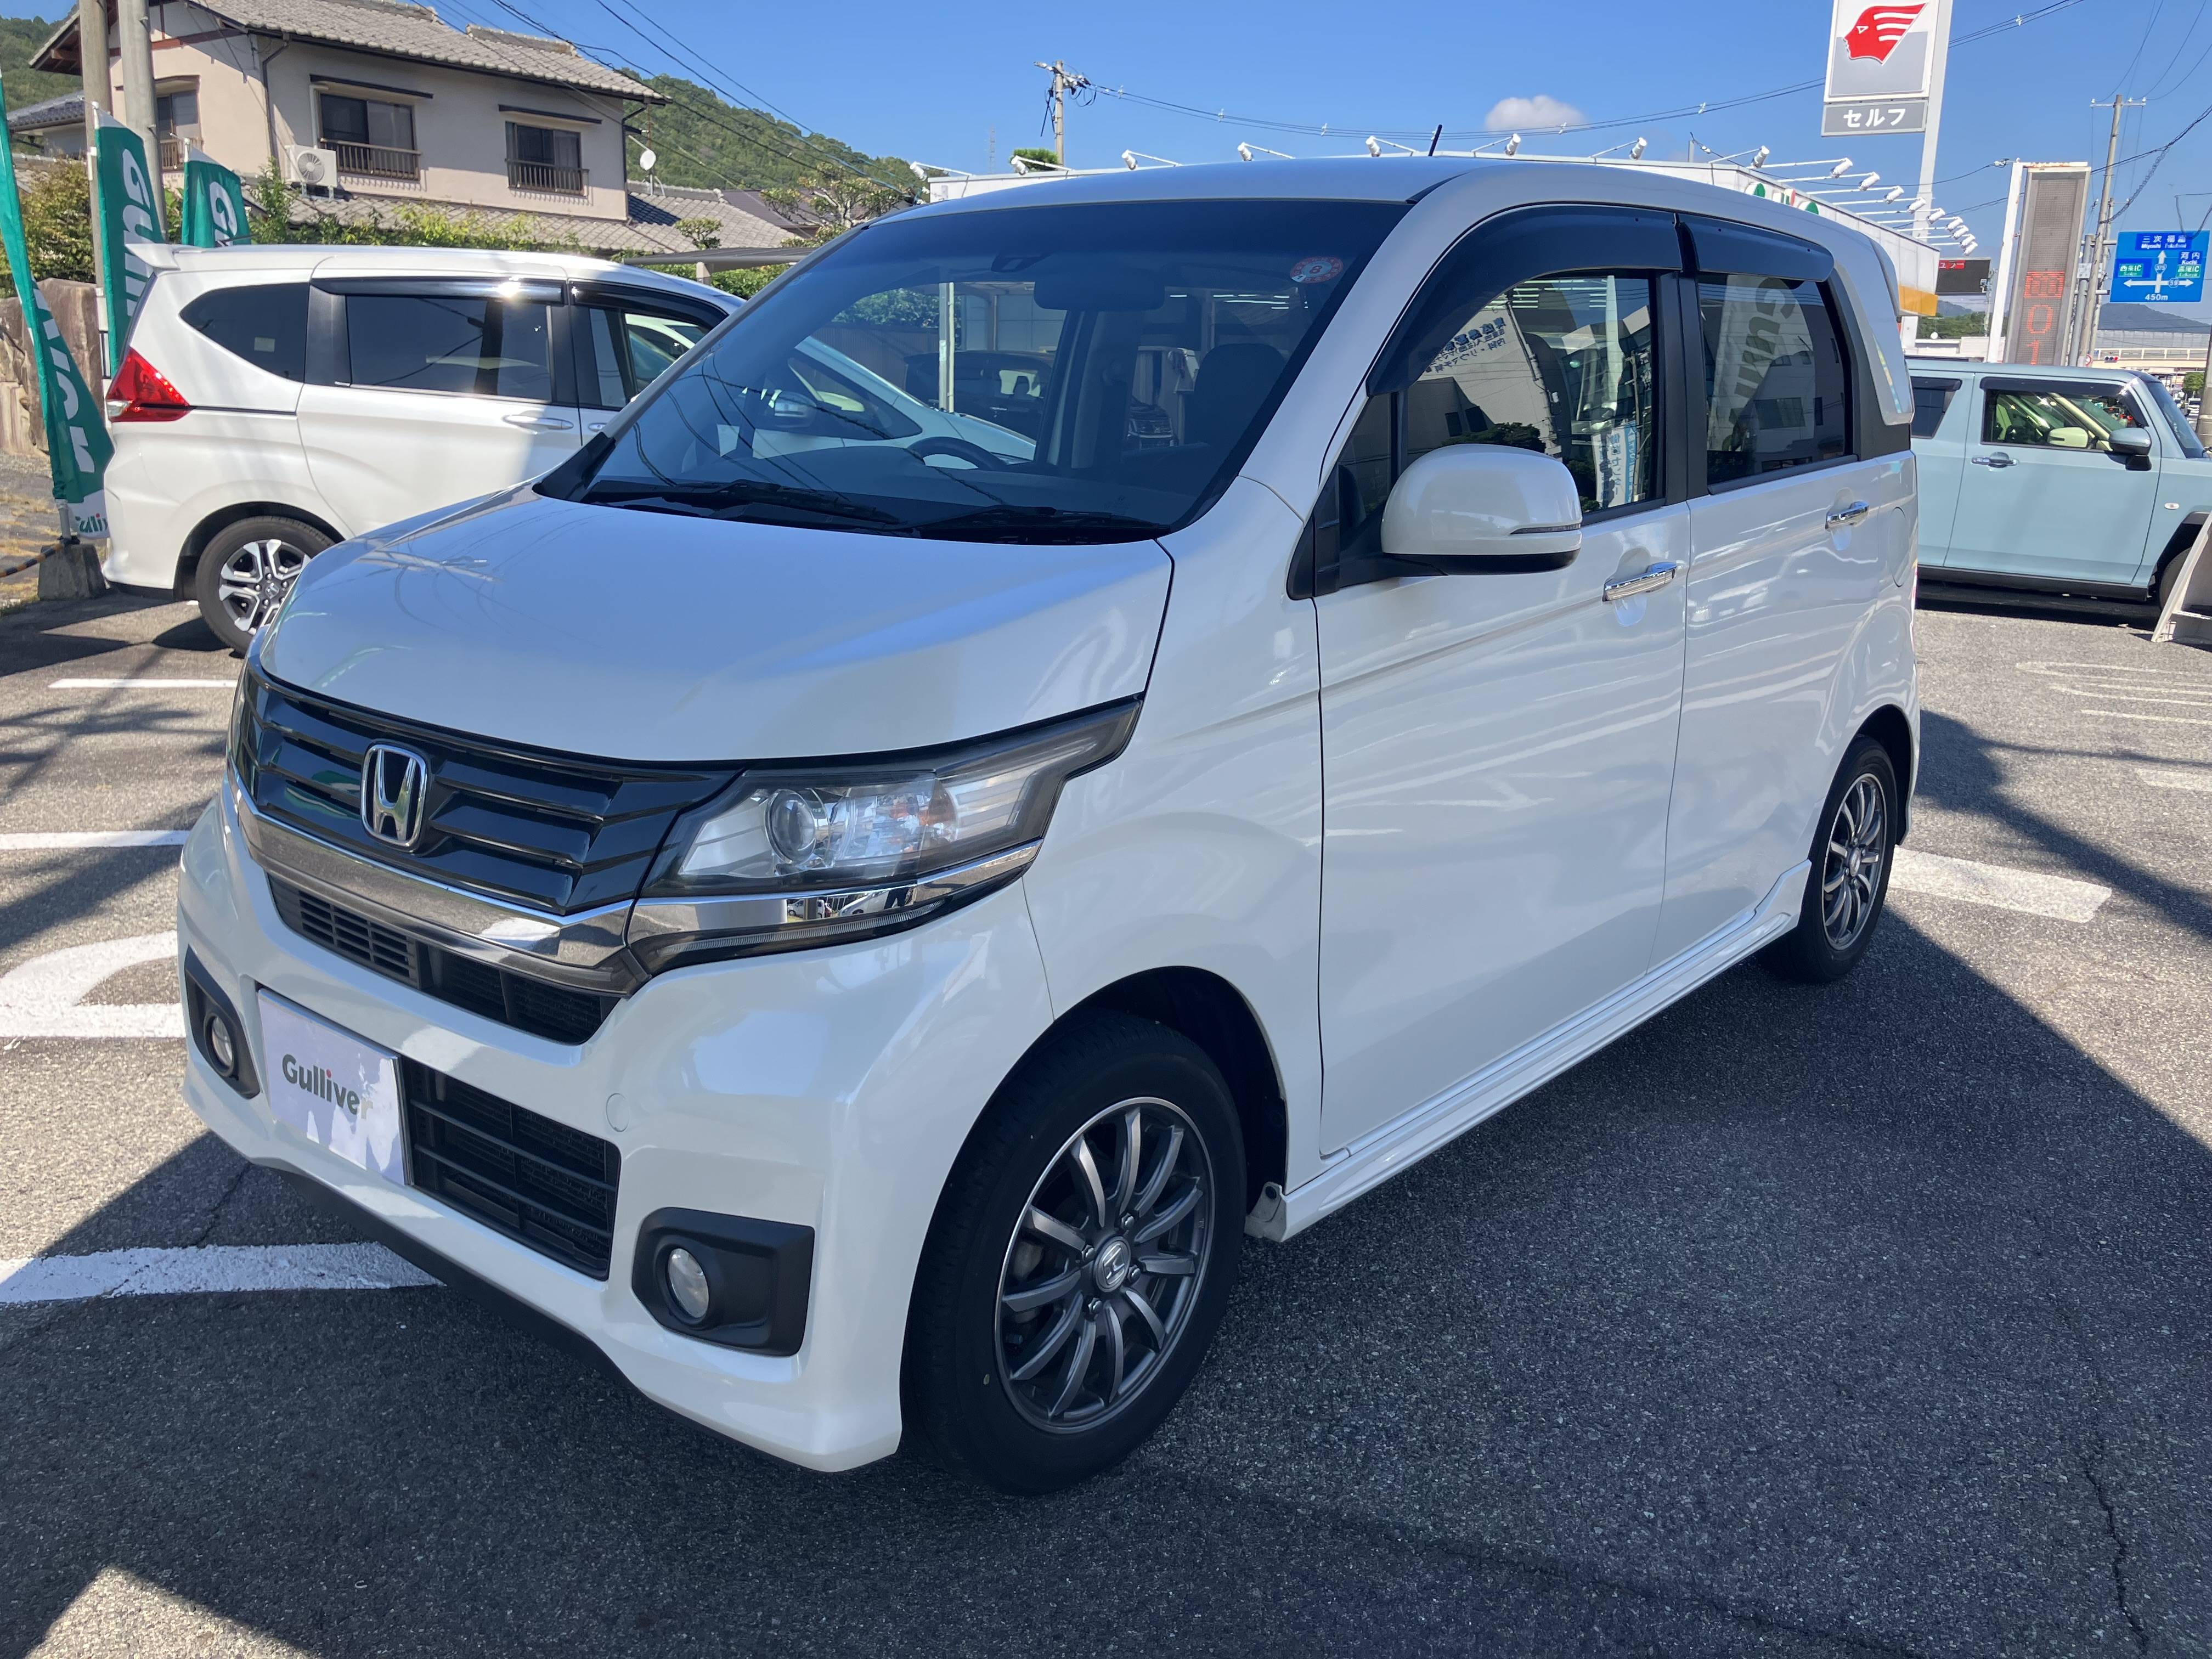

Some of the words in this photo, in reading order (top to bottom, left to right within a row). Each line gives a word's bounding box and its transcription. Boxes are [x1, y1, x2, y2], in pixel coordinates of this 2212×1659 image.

[1843, 109, 1906, 128] セルフ
[282, 1054, 374, 1120] Gulliver
